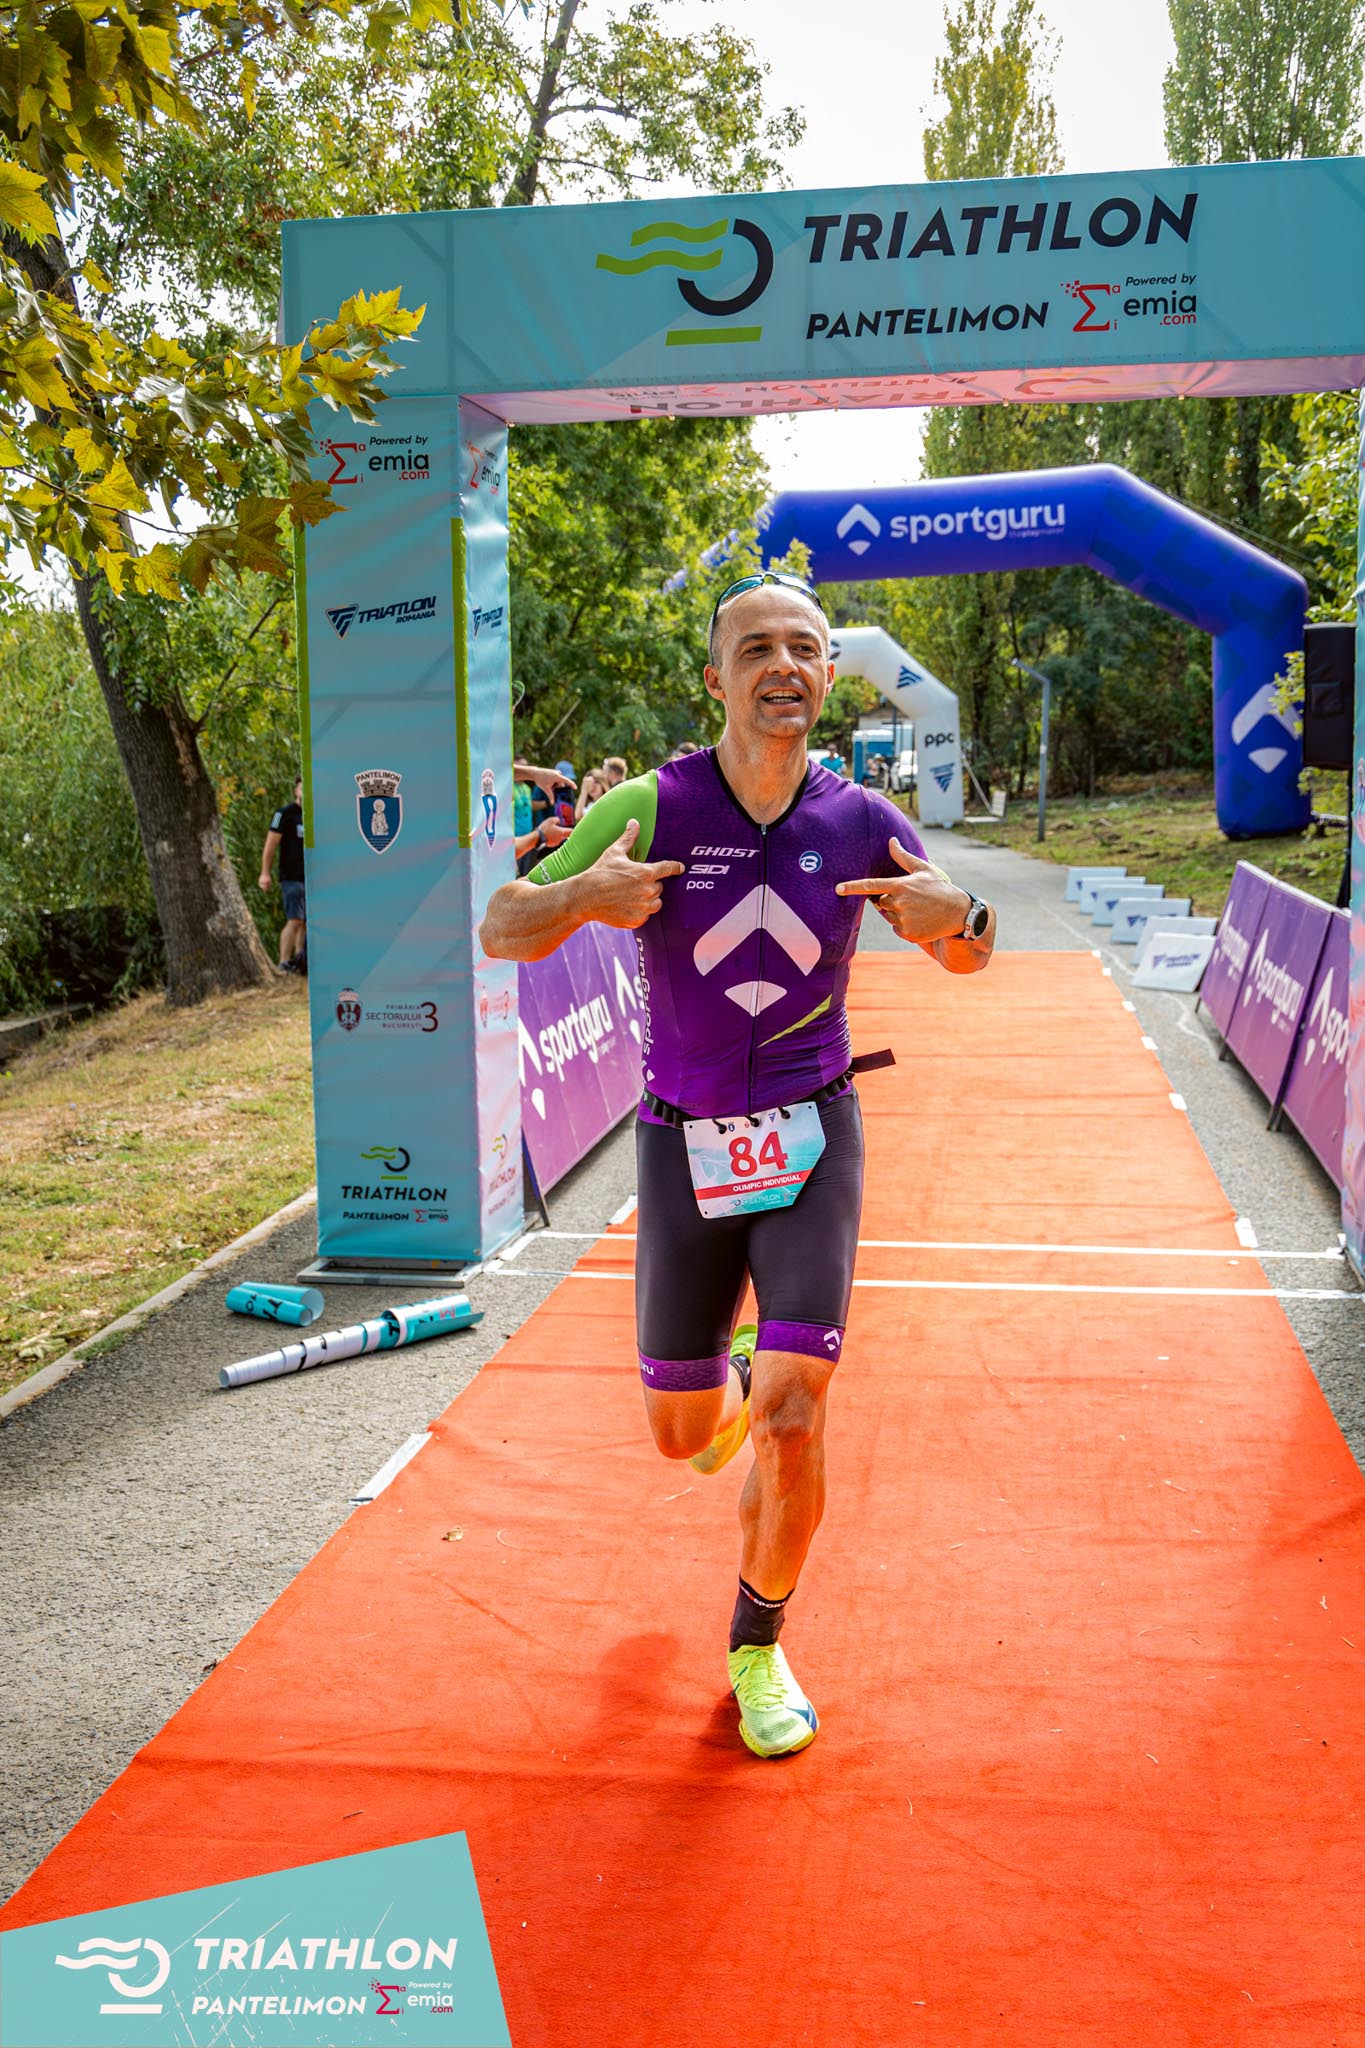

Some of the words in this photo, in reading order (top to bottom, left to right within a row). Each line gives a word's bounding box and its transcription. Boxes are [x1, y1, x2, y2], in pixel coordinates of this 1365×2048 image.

[804, 193, 1198, 264] TRIATHLON
[1125, 274, 1177, 286] Powered
[1181, 273, 1197, 285] by
[1123, 290, 1197, 316] emia
[806, 301, 1049, 339] PANTELIMON
[1159, 313, 1196, 325] .com
[369, 435, 412, 446] Powered
[415, 435, 428, 446] by
[368, 449, 429, 472] emia
[398, 470, 430, 481] .com
[889, 503, 1065, 544] sportguru
[358, 596, 436, 624] TRIATLON
[396, 609, 436, 624] ROMANIA
[925, 732, 955, 748] ppc
[356, 771, 401, 782] PANTELIMON
[690, 846, 760, 858] GHOST
[366, 1011, 421, 1021] SECTORULUI
[420, 1001, 439, 1032] 3
[538, 994, 614, 1083] sportguru
[728, 1130, 789, 1178] 84
[732, 1181, 762, 1192] OLIMPIC
[763, 1174, 801, 1187] INDIVIDUAL
[341, 1185, 448, 1201] TRIATHLON
[343, 1210, 409, 1221] PANTELIMON
